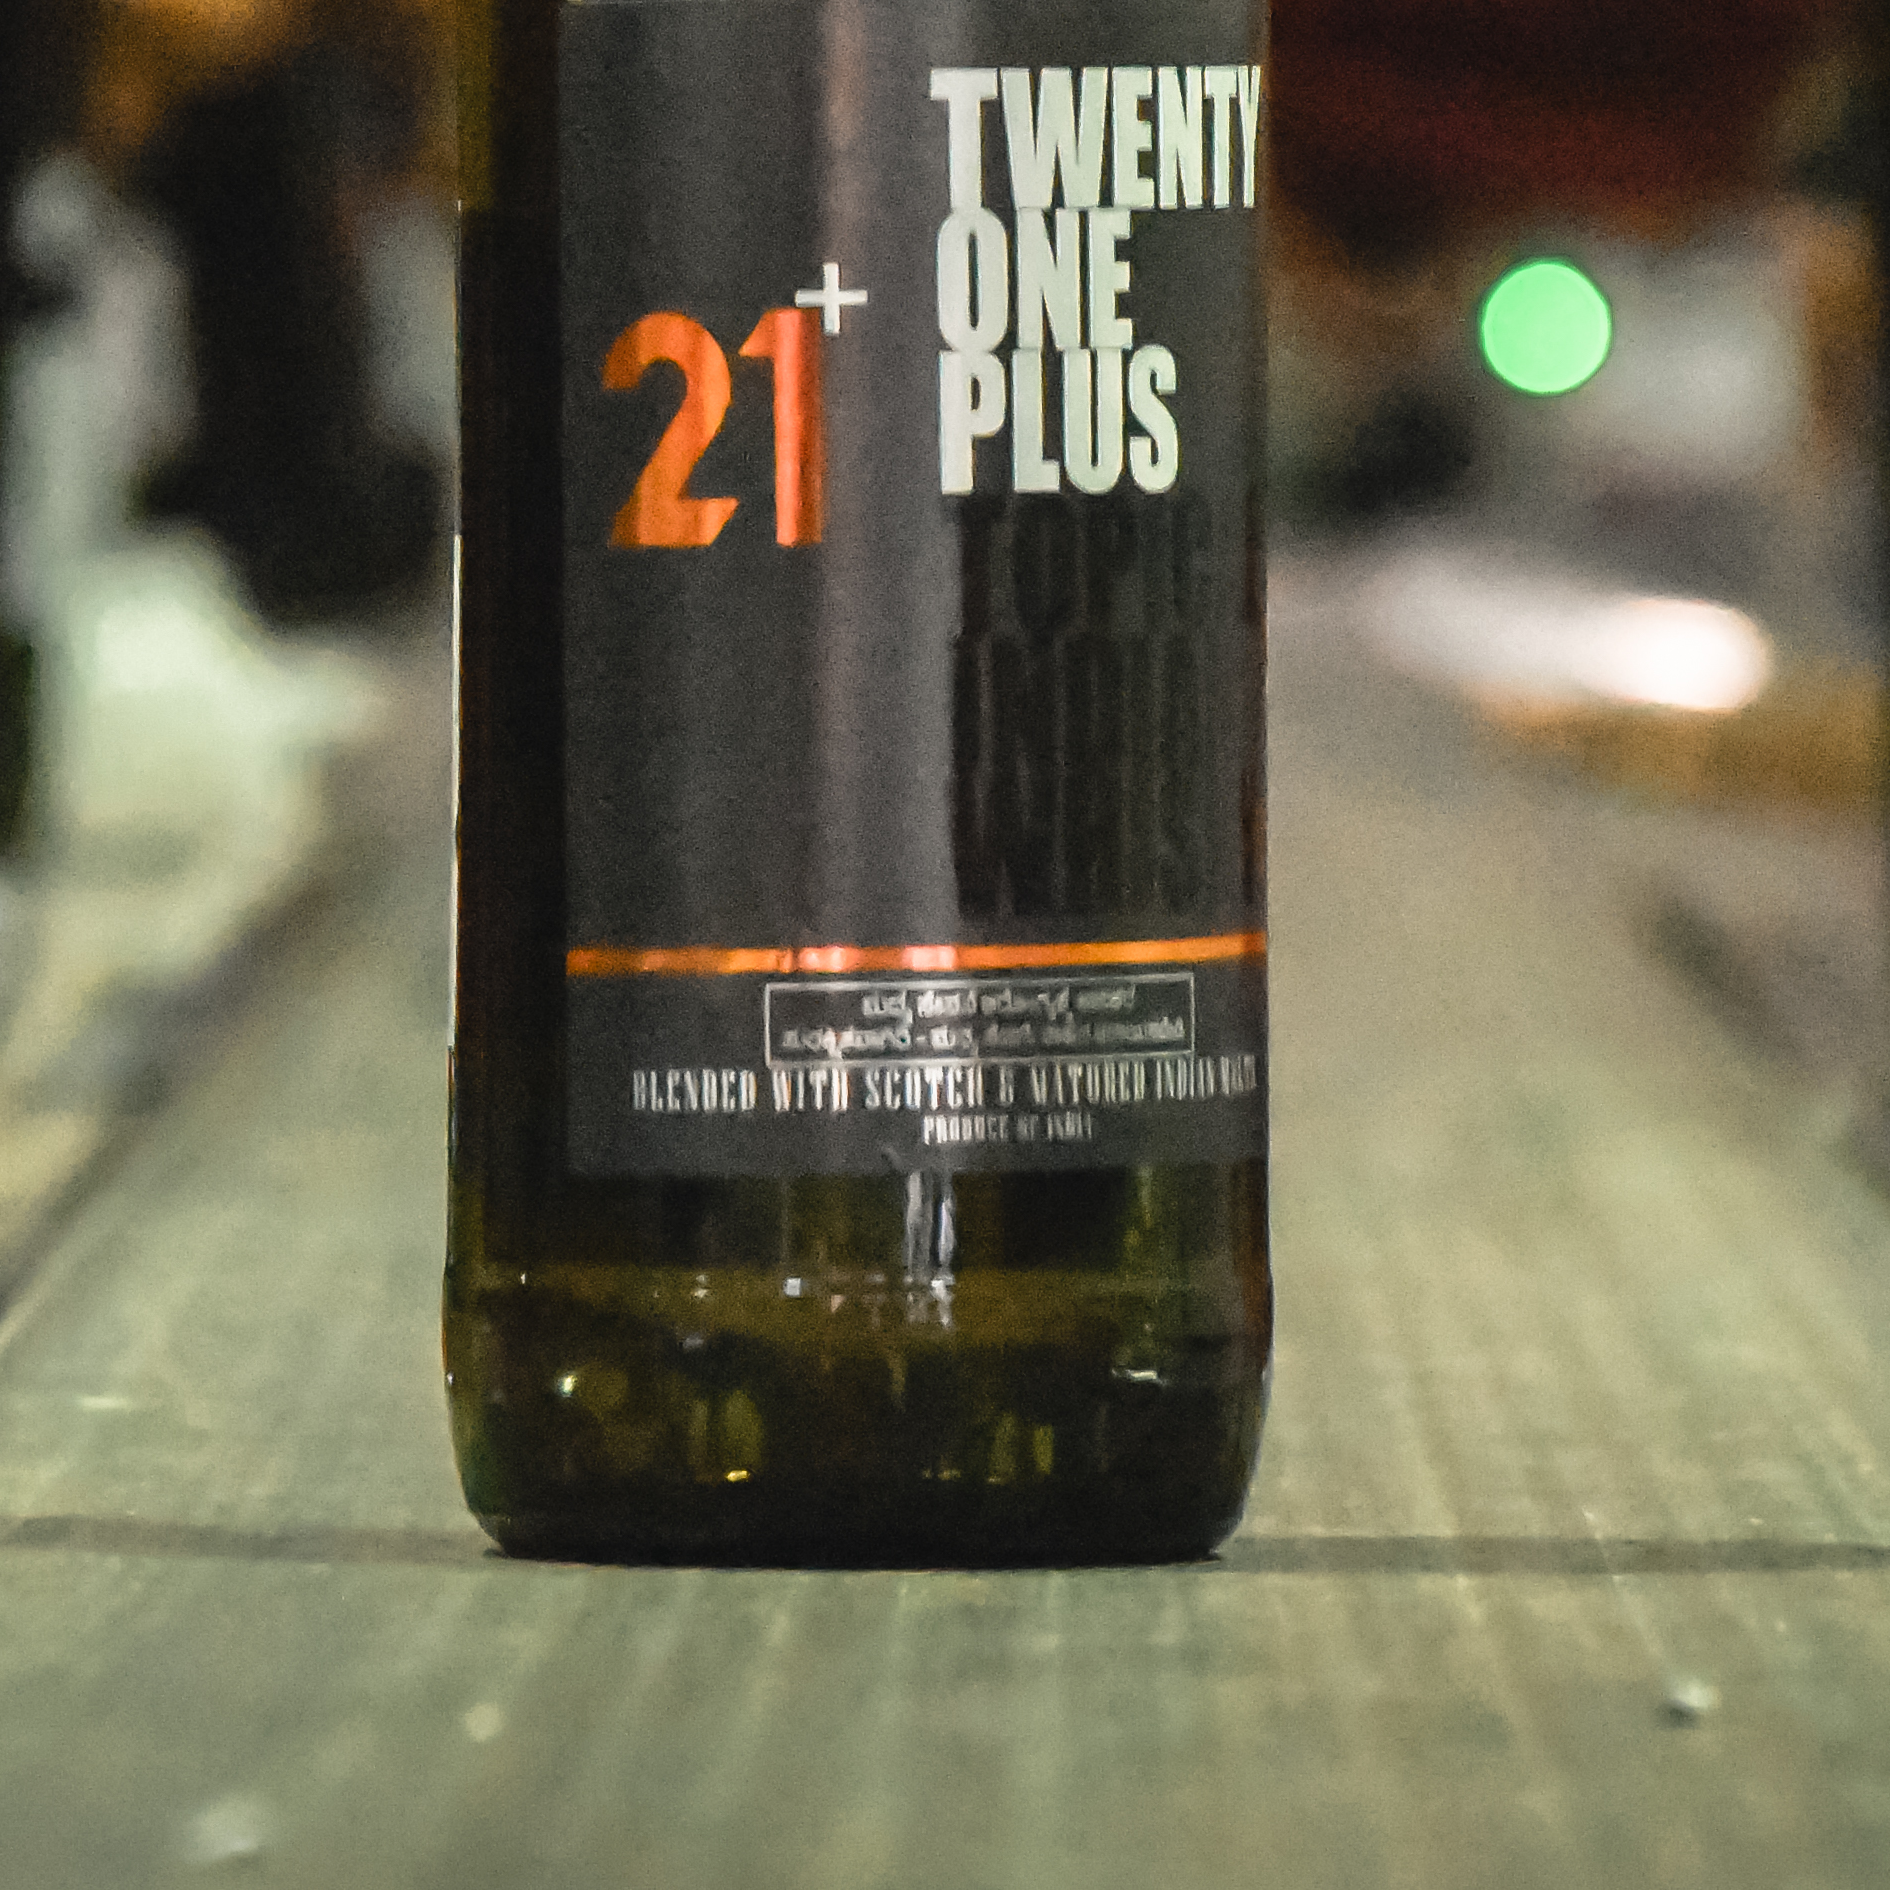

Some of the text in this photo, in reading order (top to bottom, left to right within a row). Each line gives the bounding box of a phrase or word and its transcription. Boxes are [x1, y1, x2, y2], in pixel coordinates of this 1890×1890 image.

[930, 65, 1261, 209] TWENTY
[936, 207, 1133, 351] ONE
[602, 261, 868, 548] 21+
[939, 345, 1179, 495] PLUS
[633, 1068, 757, 1111] BLENDED
[771, 1067, 850, 1111] WITH
[864, 1064, 983, 1110] SCOTCH
